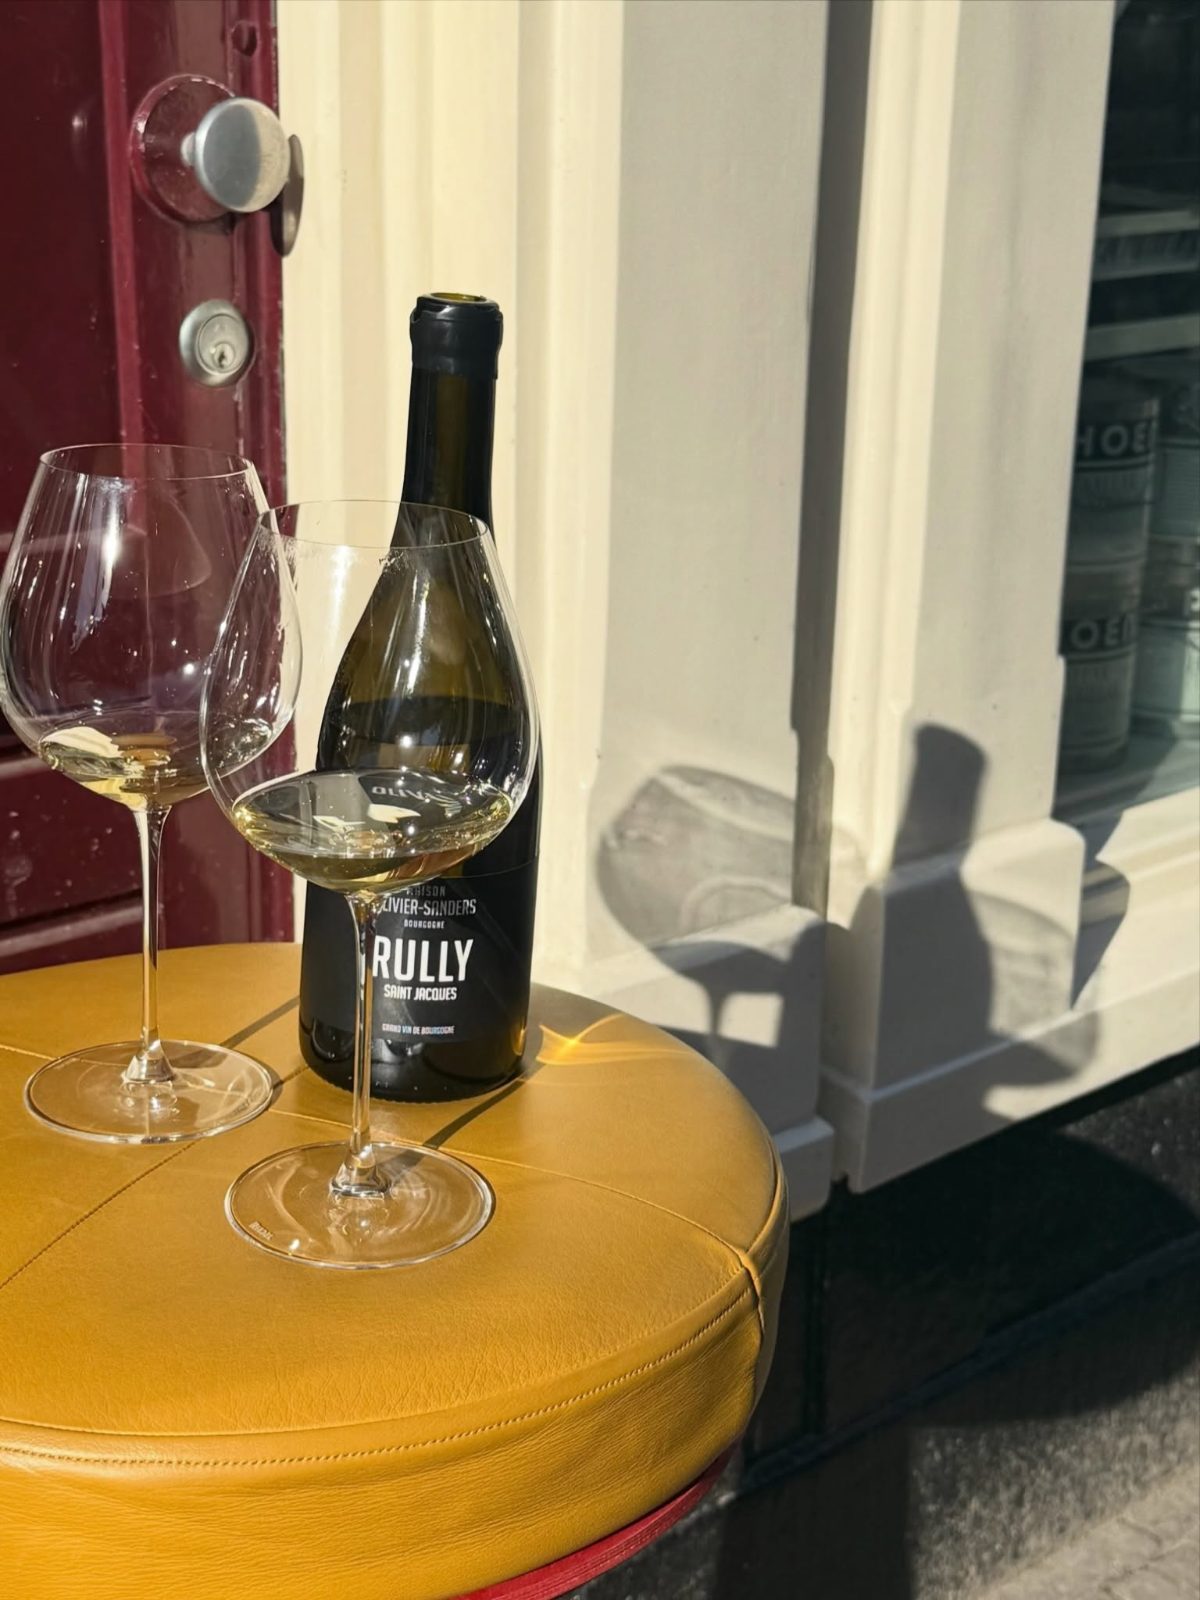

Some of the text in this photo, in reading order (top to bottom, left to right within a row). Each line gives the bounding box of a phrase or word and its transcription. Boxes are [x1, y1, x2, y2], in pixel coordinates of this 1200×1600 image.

[404, 919, 445, 930] BOURGOGNE
[372, 935, 474, 982] RULLY
[384, 984, 457, 1001] SAINT JACQUES
[402, 1024, 412, 1034] VIN
[412, 1025, 420, 1035] DE
[421, 1025, 455, 1035] BOURGOGNE
